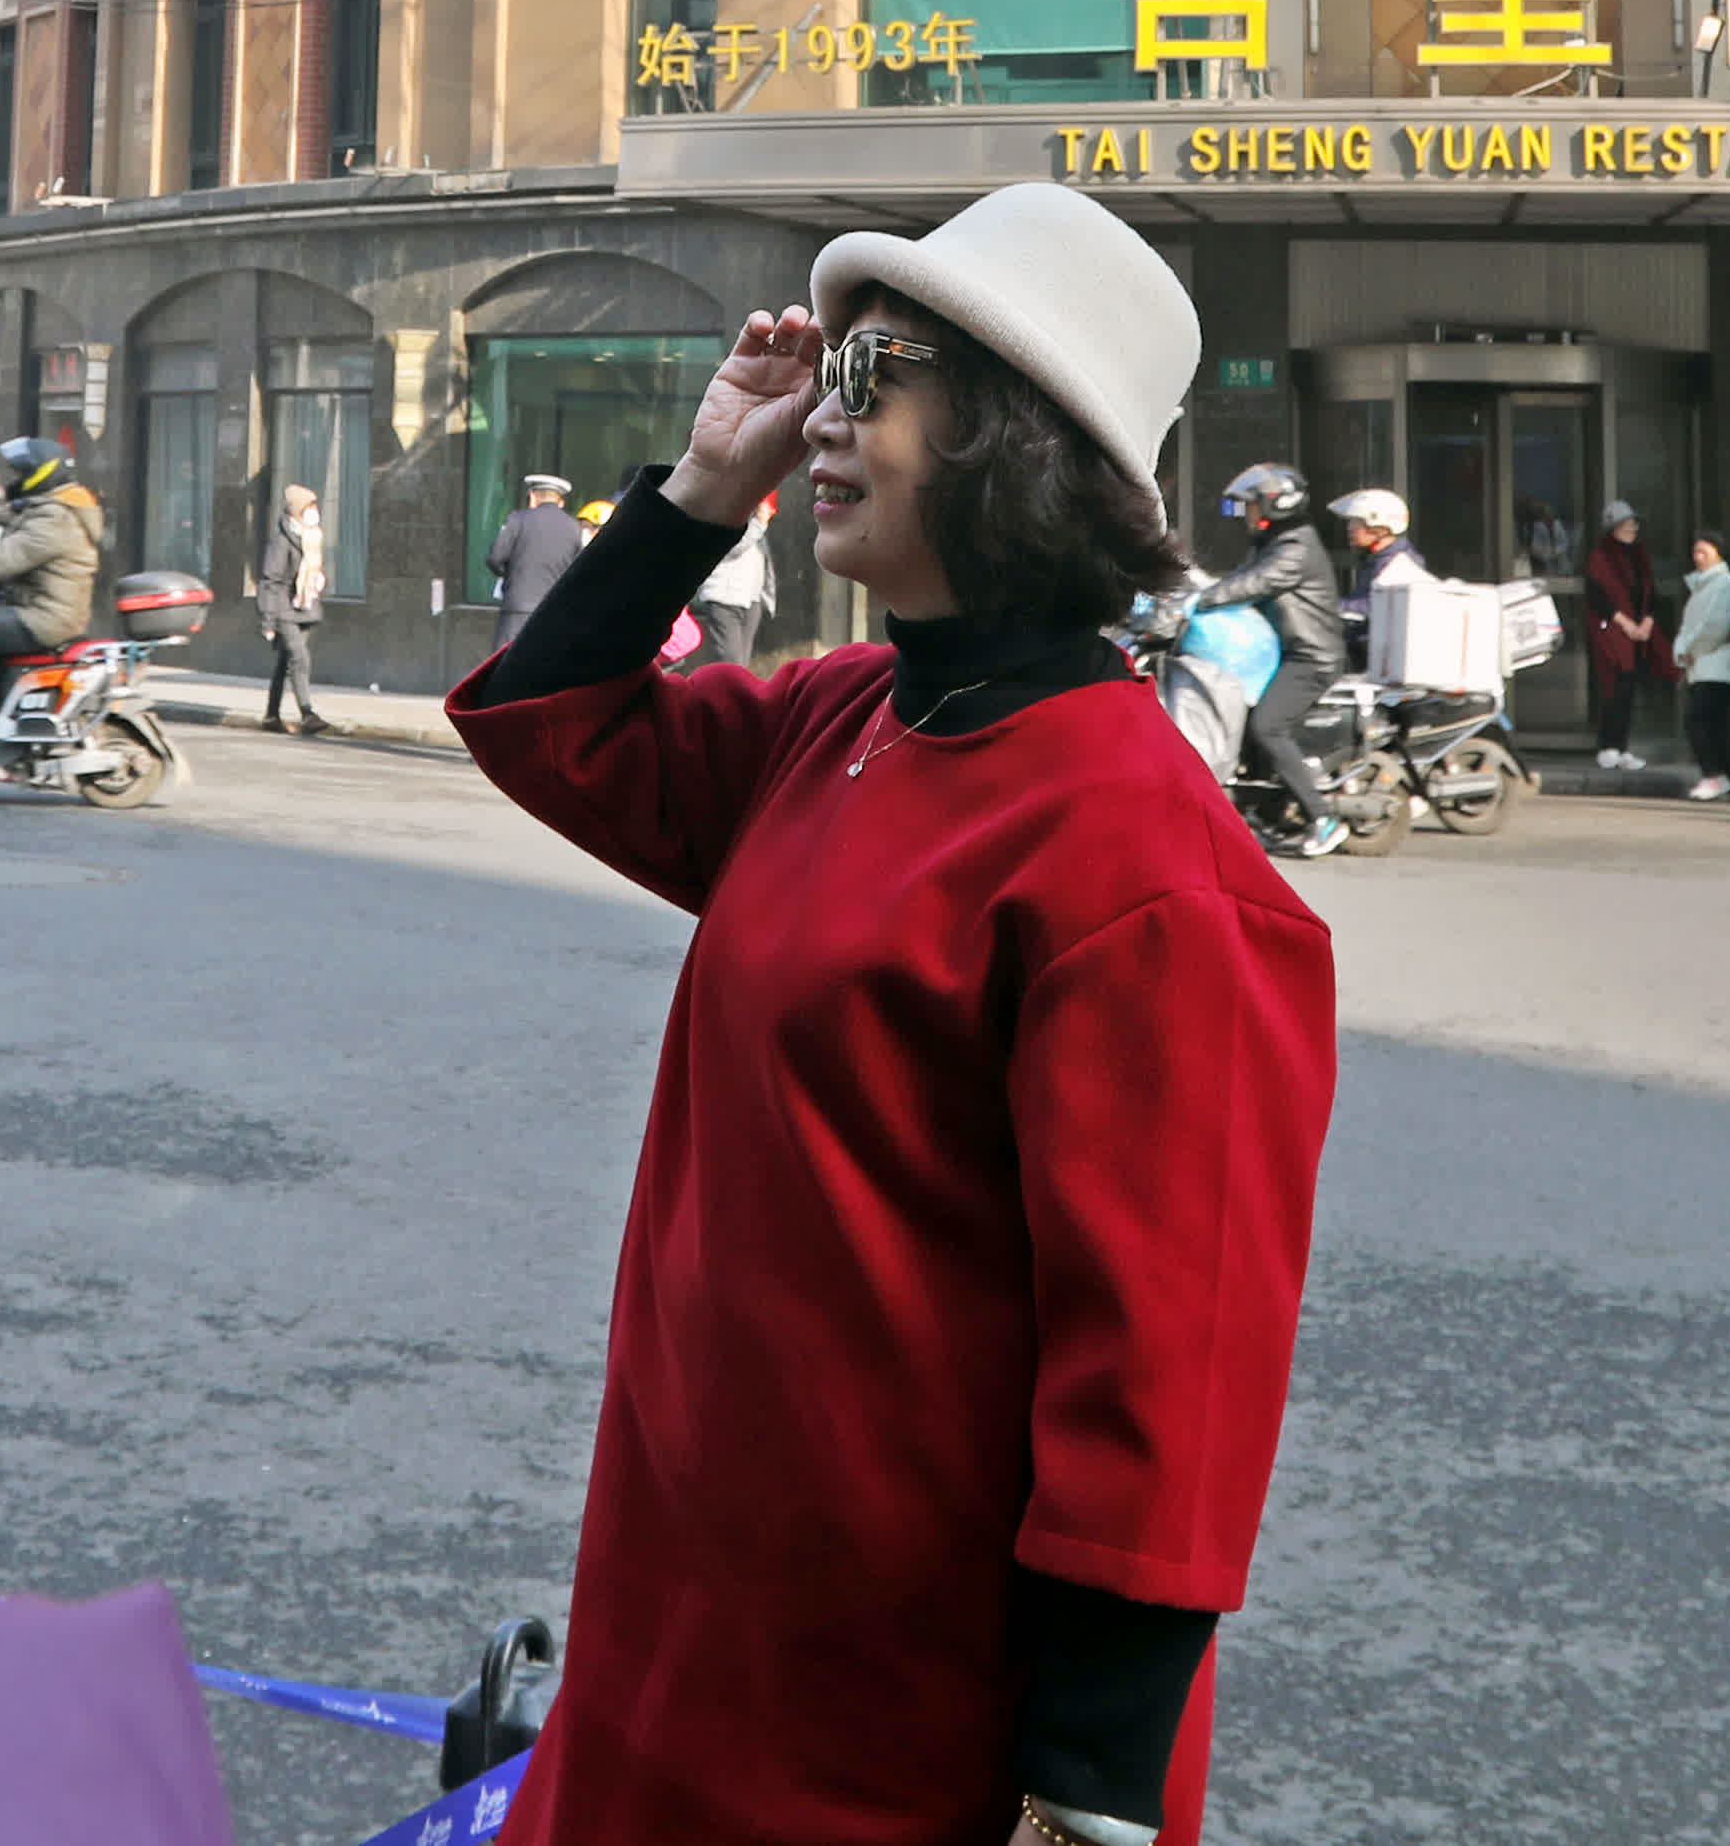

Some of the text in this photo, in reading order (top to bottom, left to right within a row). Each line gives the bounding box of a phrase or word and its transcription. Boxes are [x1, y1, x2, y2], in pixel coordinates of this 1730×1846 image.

[636, 11, 983, 88] 始于1993年
[1058, 128, 1152, 173] TAI
[1189, 124, 1373, 173] SHENG
[1404, 123, 1553, 172] YUAN
